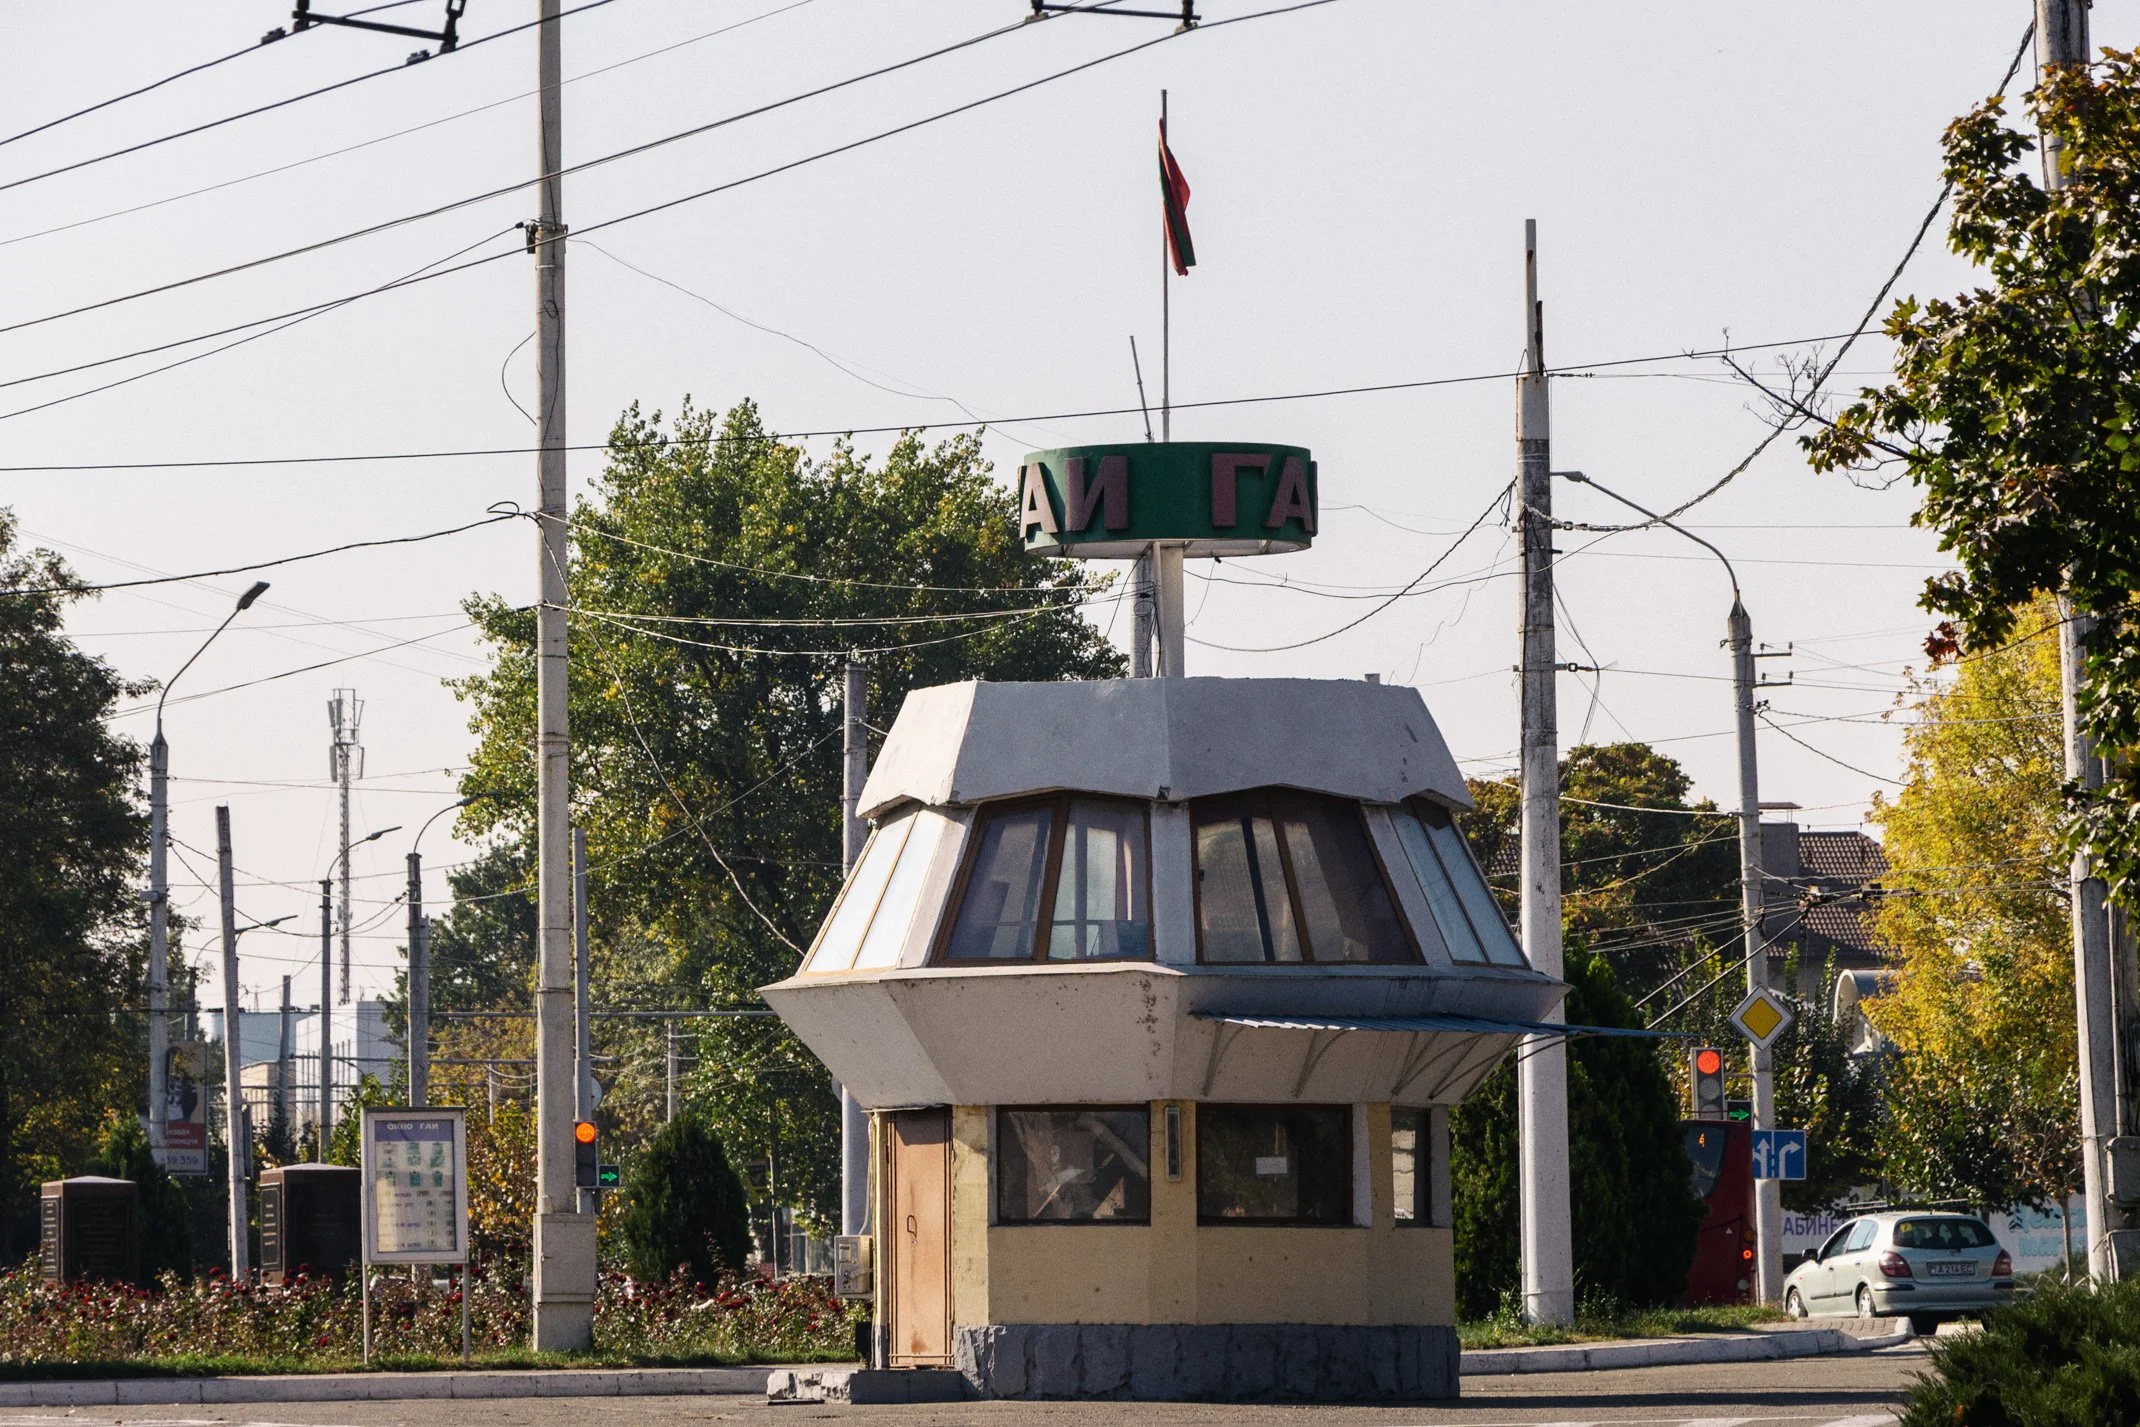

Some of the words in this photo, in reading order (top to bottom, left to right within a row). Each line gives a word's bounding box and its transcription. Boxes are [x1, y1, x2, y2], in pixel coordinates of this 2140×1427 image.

[1017, 456, 1128, 538] АИ
[1212, 453, 1318, 536] ГА
[420, 1122, 440, 1130] ГАИ
[1699, 1133, 1705, 1148] 4
[1783, 1216, 1847, 1236] АБИНЕ
